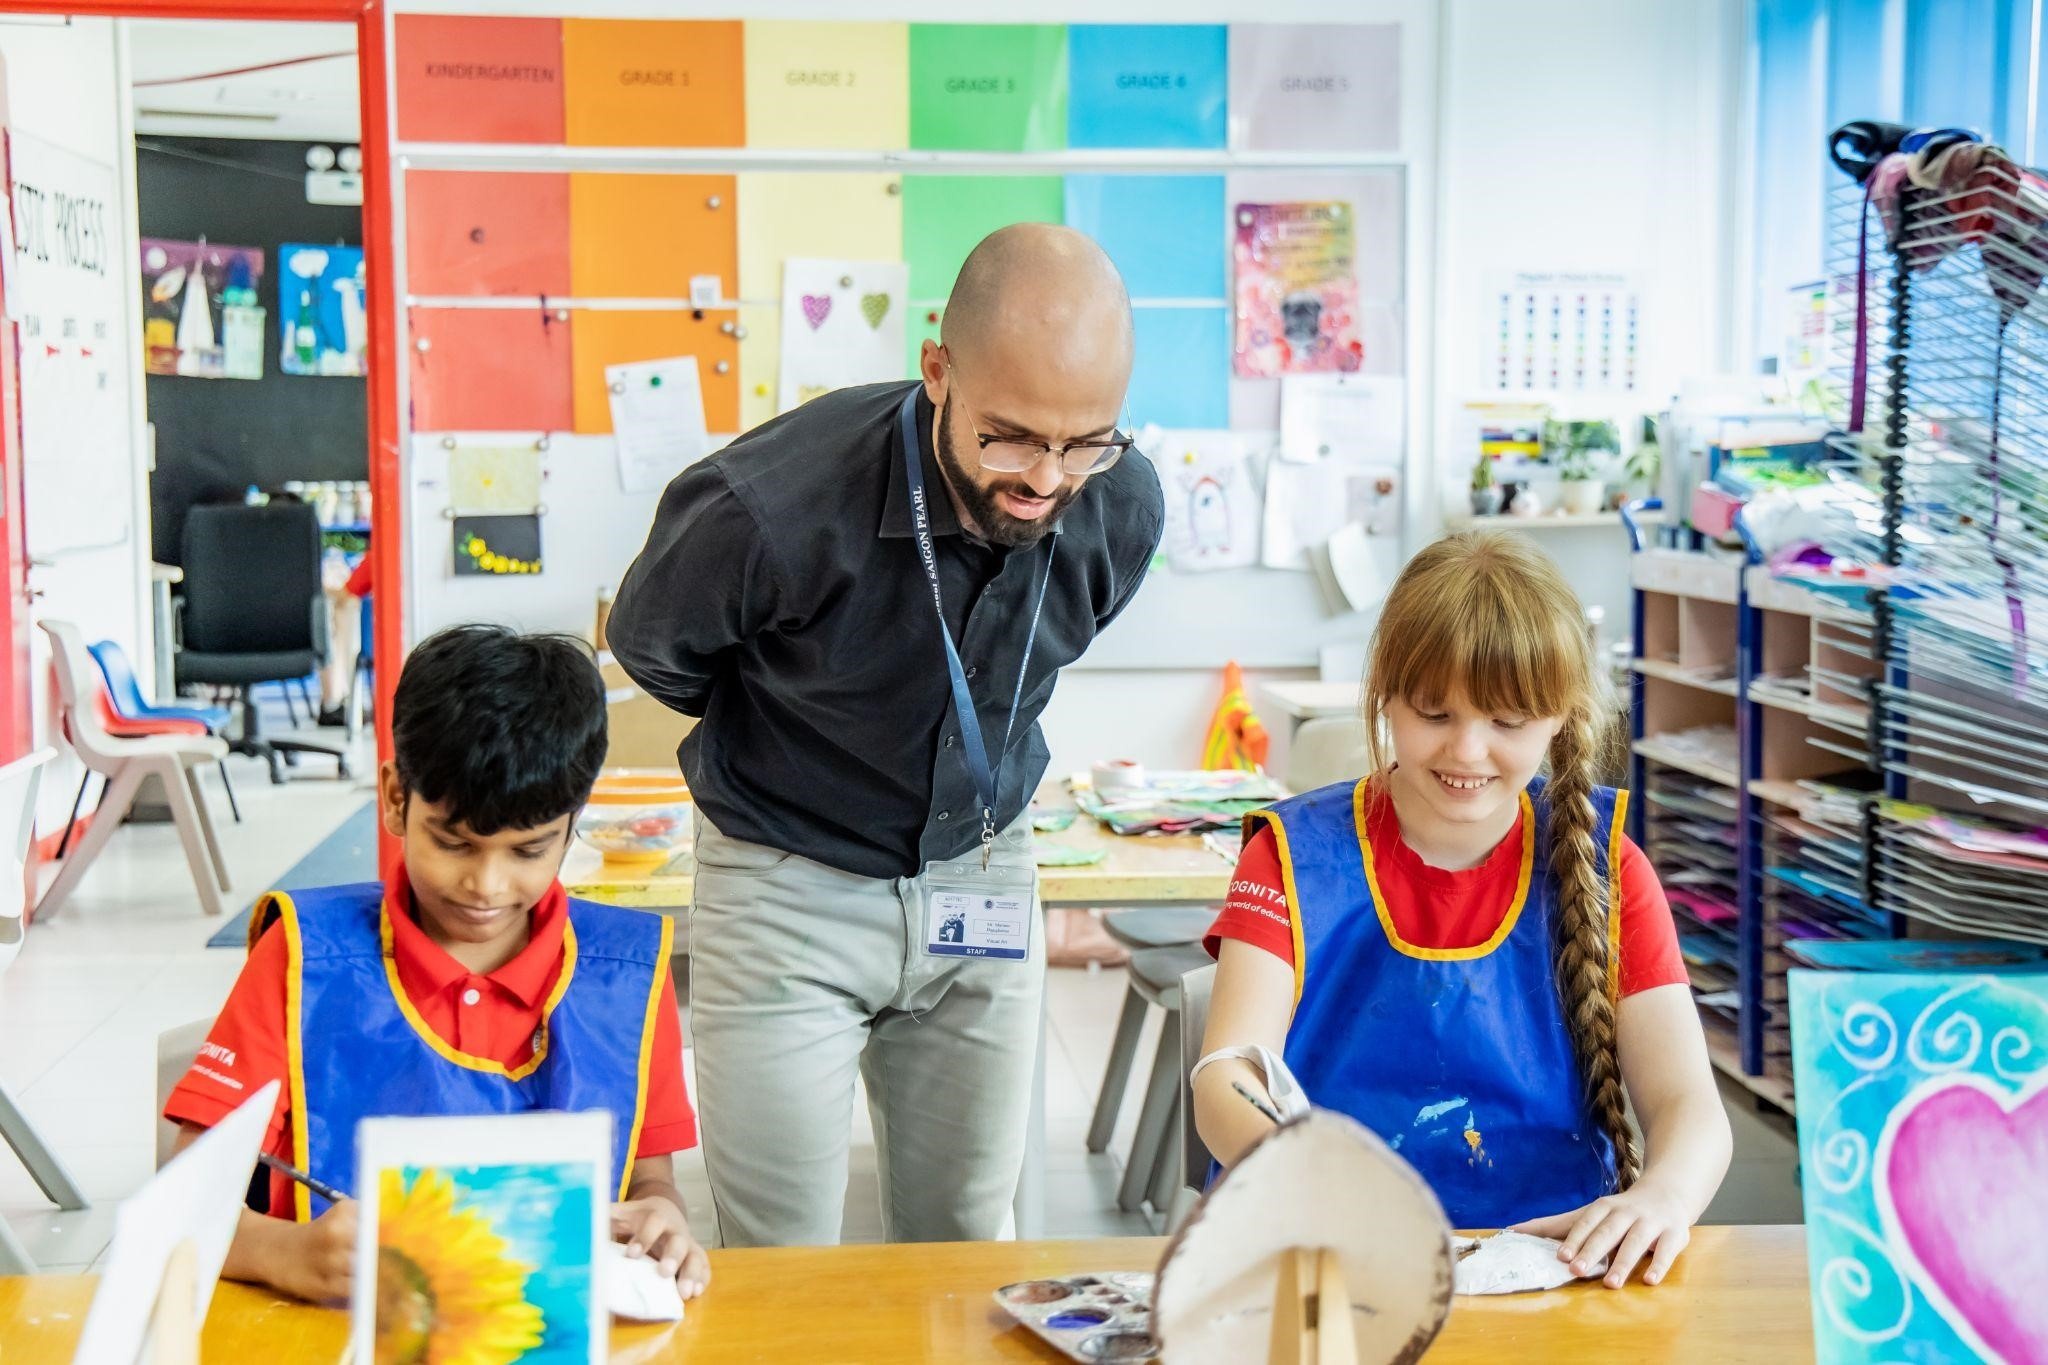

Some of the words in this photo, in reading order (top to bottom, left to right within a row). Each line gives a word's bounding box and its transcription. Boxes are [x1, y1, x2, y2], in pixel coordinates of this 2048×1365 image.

[425, 63, 554, 83] KINDERGARTEN
[619, 70, 674, 86] GRADE
[682, 70, 690, 87] 1
[785, 70, 839, 86] GRADE
[845, 71, 855, 87] 2
[1115, 73, 1170, 89] GRADE
[1174, 73, 1187, 89] 4
[945, 77, 998, 93] GRADE
[1005, 77, 1015, 93] 3
[1279, 76, 1334, 92] GRADE
[1340, 76, 1350, 92] 5
[913, 486, 927, 529] PEARL
[919, 531, 937, 580] SAIGON
[1231, 881, 1287, 907] OGNITA
[1233, 901, 1250, 910] world
[1250, 904, 1262, 913] of
